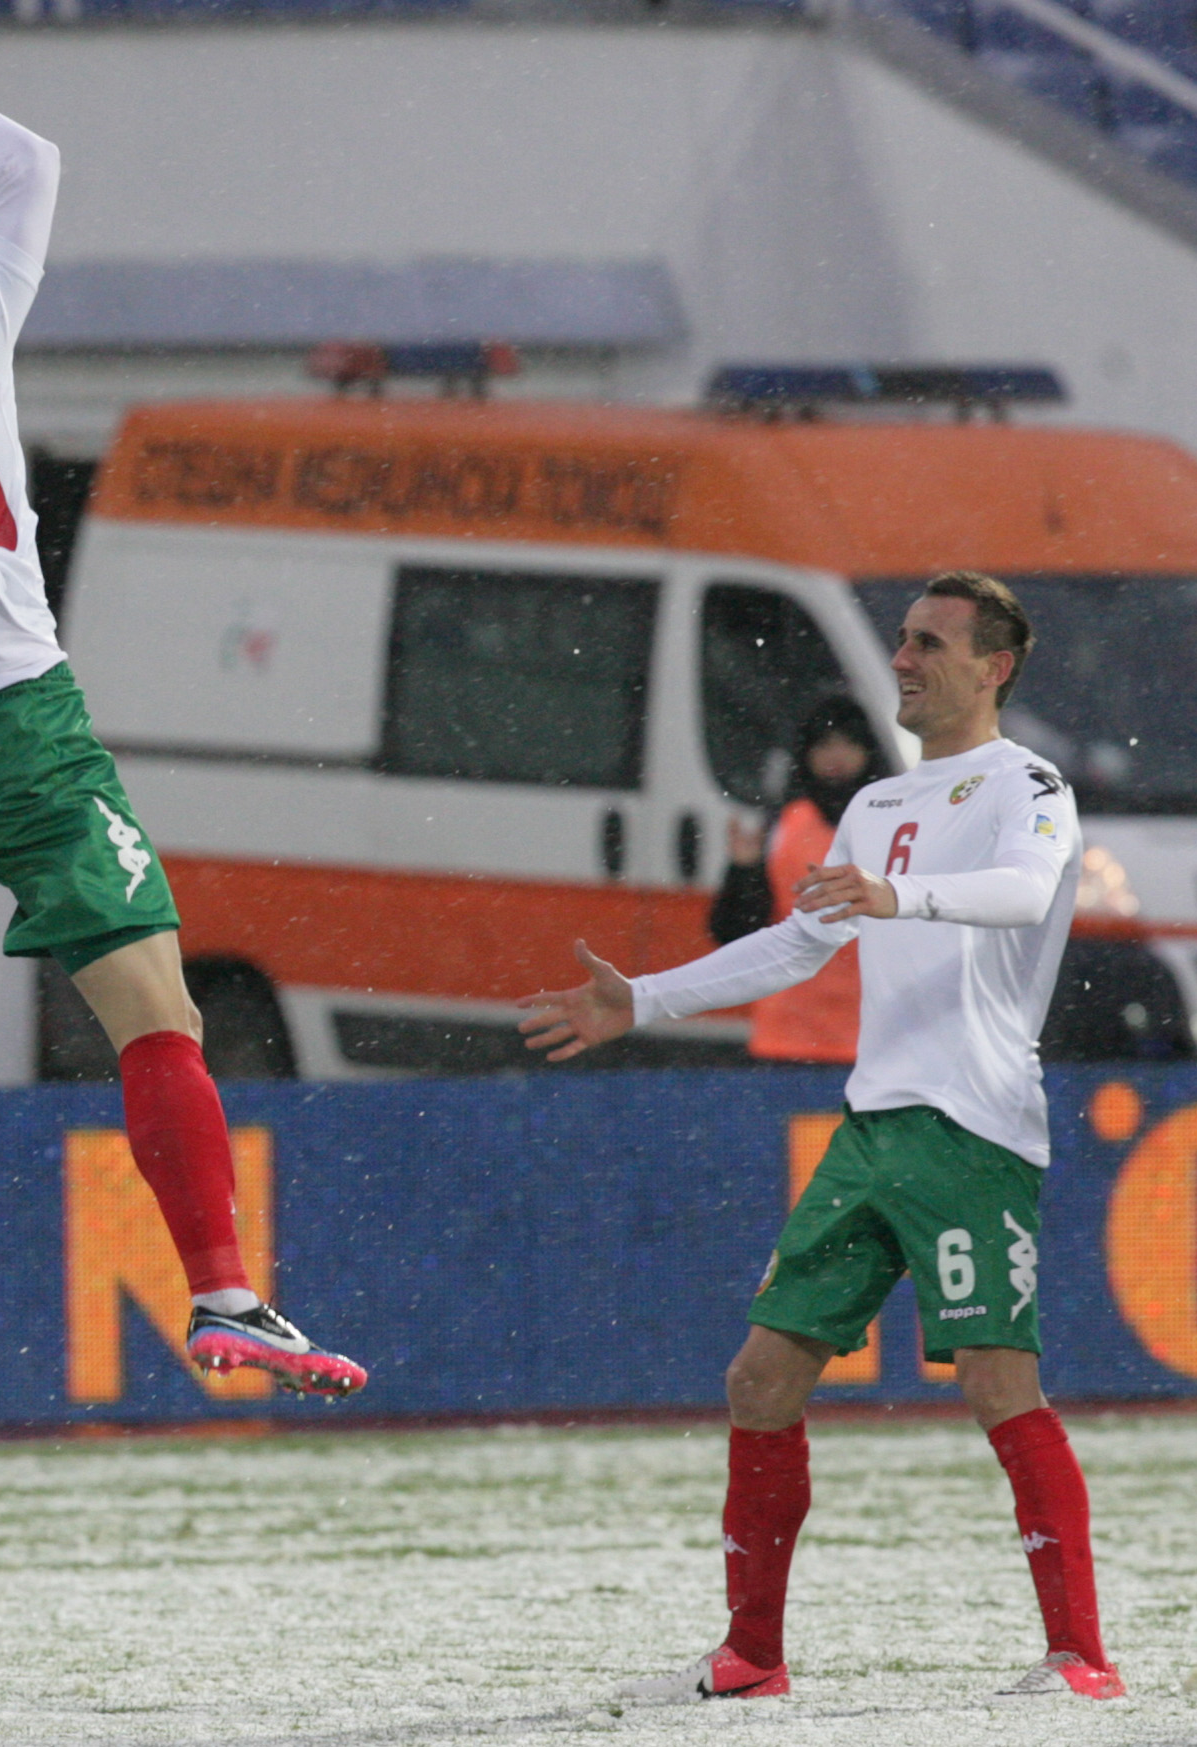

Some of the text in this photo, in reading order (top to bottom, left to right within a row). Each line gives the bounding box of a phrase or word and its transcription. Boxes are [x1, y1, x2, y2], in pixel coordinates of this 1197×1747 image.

[884, 821, 919, 876] 6
[936, 1227, 975, 1301] 6
[939, 1304, 987, 1320] Kappa
